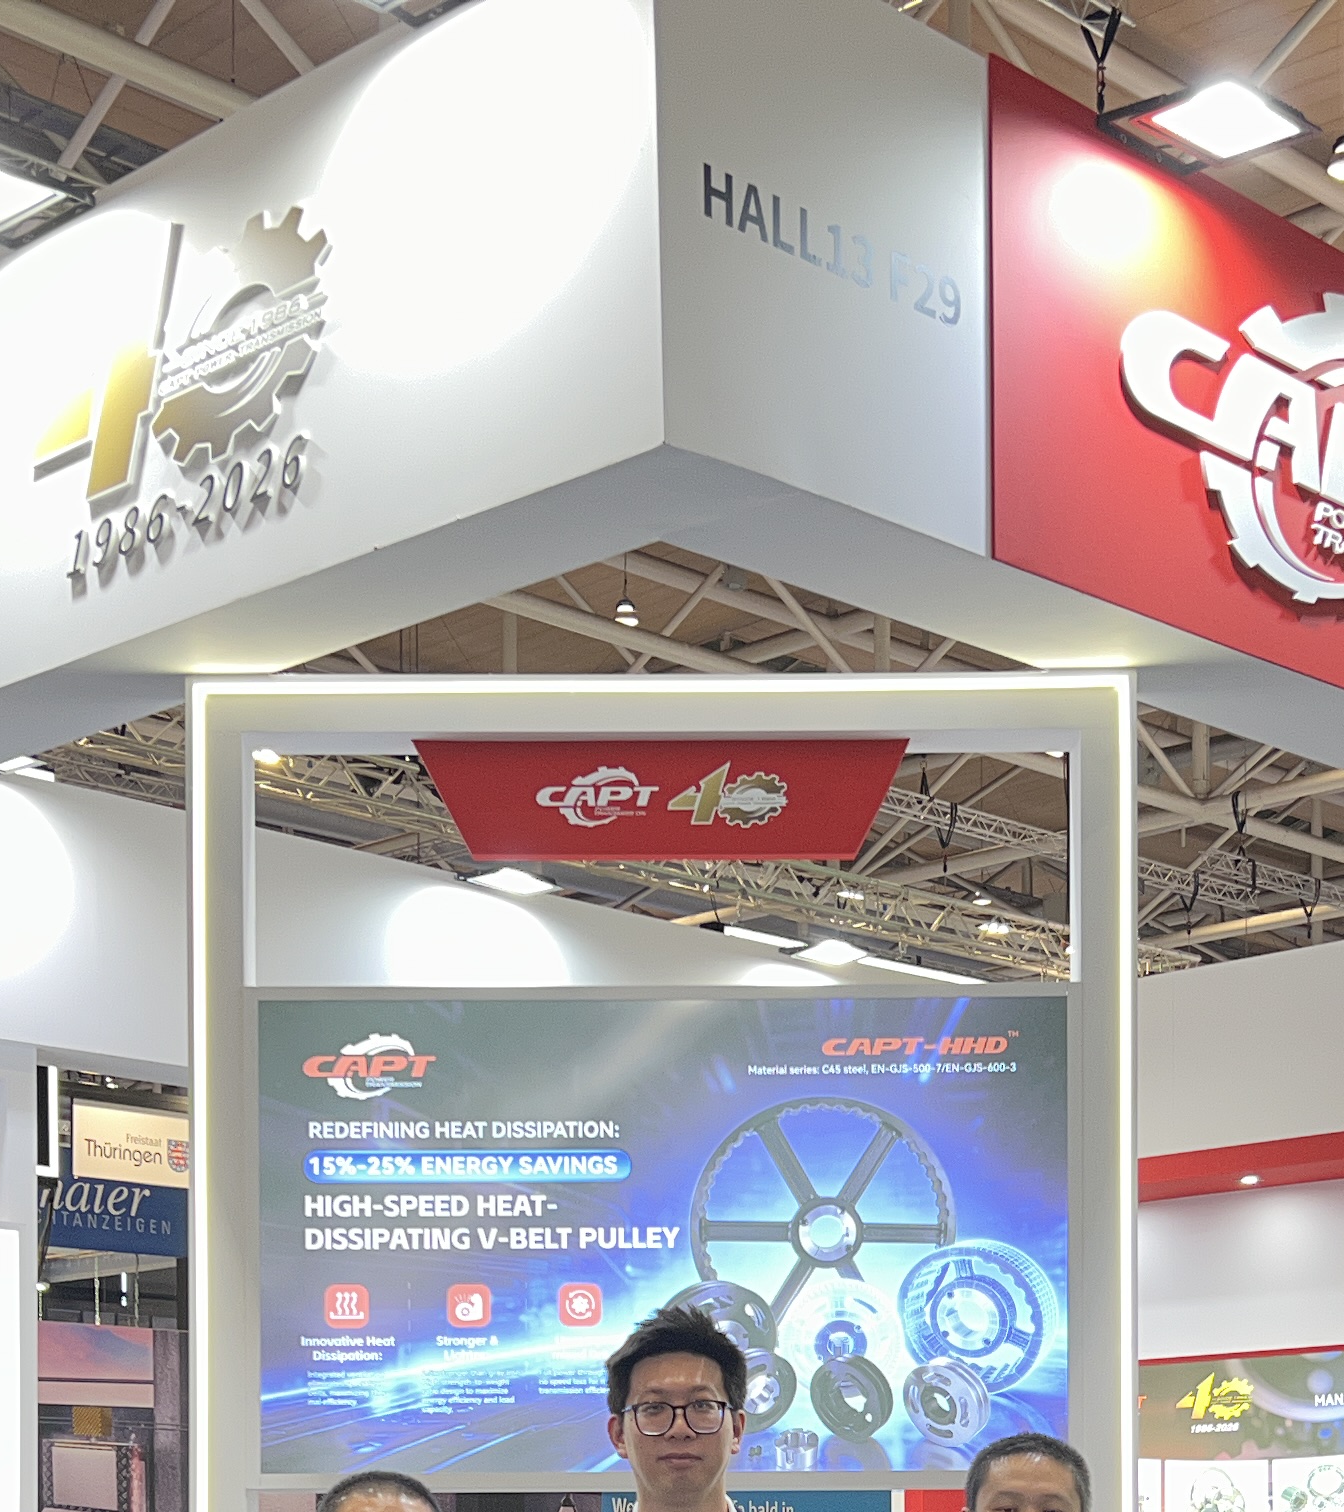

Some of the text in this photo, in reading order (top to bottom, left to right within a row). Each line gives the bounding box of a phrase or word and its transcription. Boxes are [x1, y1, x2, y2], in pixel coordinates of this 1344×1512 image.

[702, 163, 962, 326] HALL13 F29
[66, 431, 311, 580] 1986-2026
[536, 785, 659, 808] CAPT
[822, 1035, 1009, 1057] CAPT-HHD
[302, 1054, 437, 1078] CAPT
[748, 1064, 788, 1076] Material
[789, 1064, 820, 1076] series:
[822, 1064, 842, 1076] C45
[843, 1063, 870, 1077] steel,
[126, 1132, 163, 1149] Freistaat
[308, 1120, 621, 1140] REDEFINING HEAT DISSIPATION:
[84, 1138, 163, 1167] Thüringen
[309, 1155, 619, 1177] 15%-25% ENERGY SAVINGS
[304, 1193, 559, 1218] HIGH-SPEED HEAT-
[304, 1225, 680, 1251] DISSIPATING V-BELT PULLEY
[301, 1335, 396, 1348] Innovative Heat
[436, 1335, 488, 1350] Stronger
[312, 1350, 384, 1364] Dissipation:
